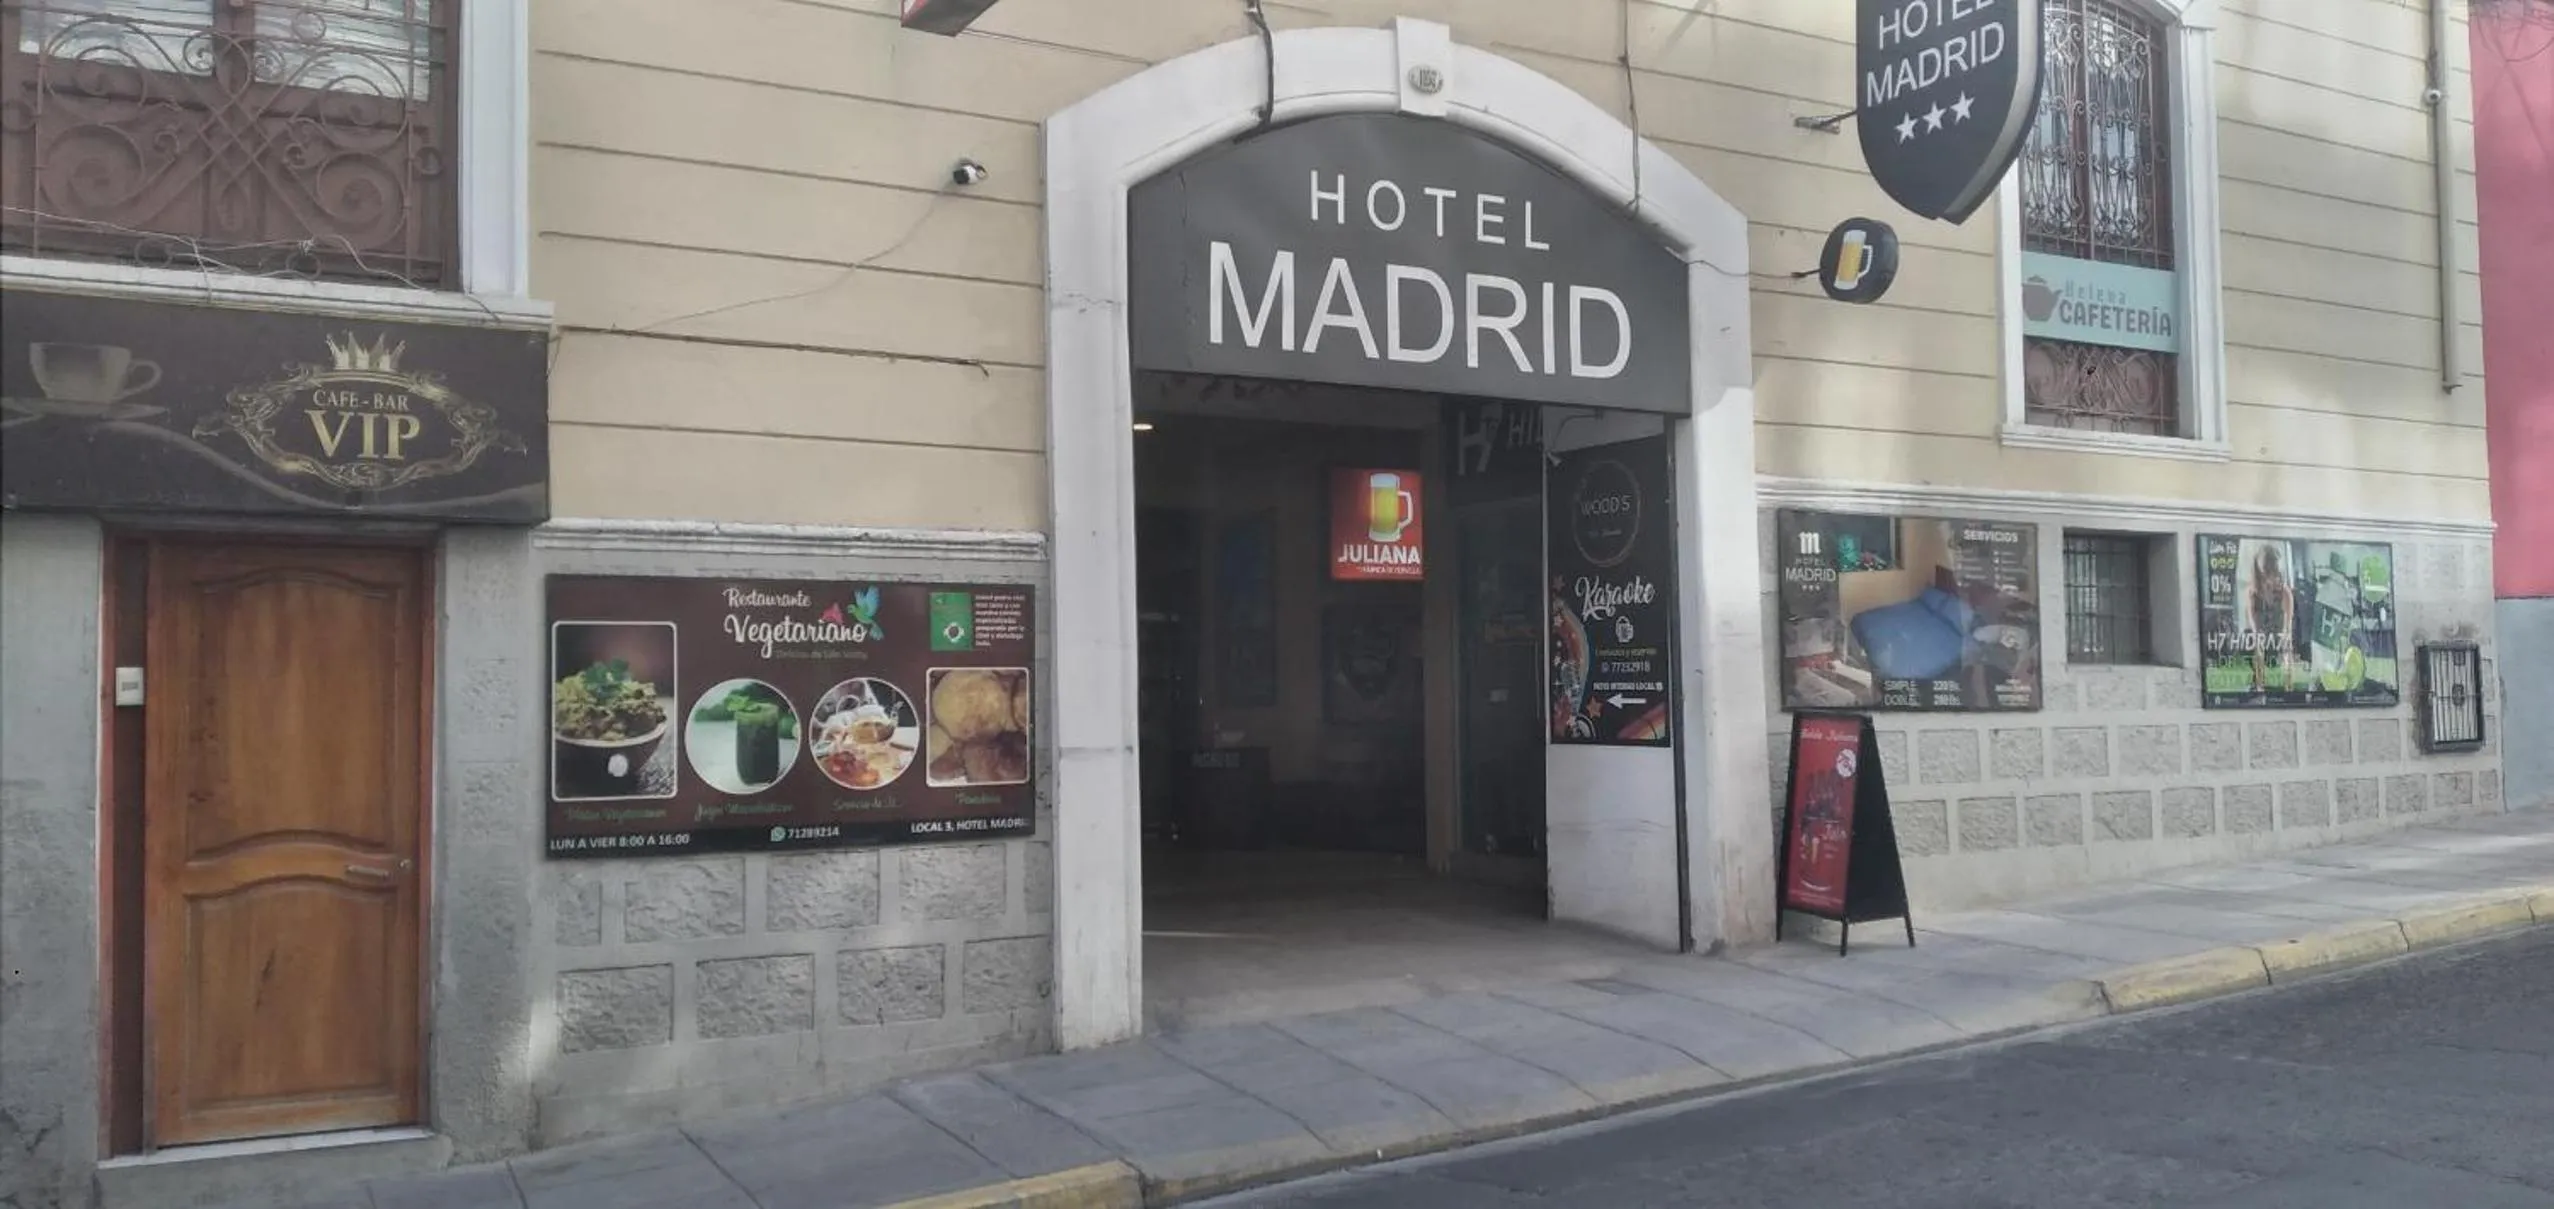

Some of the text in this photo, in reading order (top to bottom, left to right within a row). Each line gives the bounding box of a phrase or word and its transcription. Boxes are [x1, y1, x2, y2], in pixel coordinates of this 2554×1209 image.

[1866, 21, 2005, 107] MADRID
[1310, 169, 1551, 251] HOTEL
[1208, 240, 1632, 380] MADRID
[2058, 298, 2172, 338] CAFETERÍA
[373, 392, 409, 412] BAR
[303, 408, 421, 461] VIP
[1963, 529, 2019, 543] SERVICIOS
[1337, 543, 1422, 565] JULIANA
[1785, 566, 1837, 583] MADRID
[2210, 573, 2232, 593] 0%
[722, 587, 813, 608] Restaurante
[1574, 575, 1656, 622] Karaoke
[723, 612, 869, 660] Vegetariano
[2207, 631, 2226, 651] H7
[910, 821, 945, 834] LOCAL
[956, 818, 989, 831] HOTEL
[550, 833, 691, 851] LUN A VIER 8:00 A 16:00
